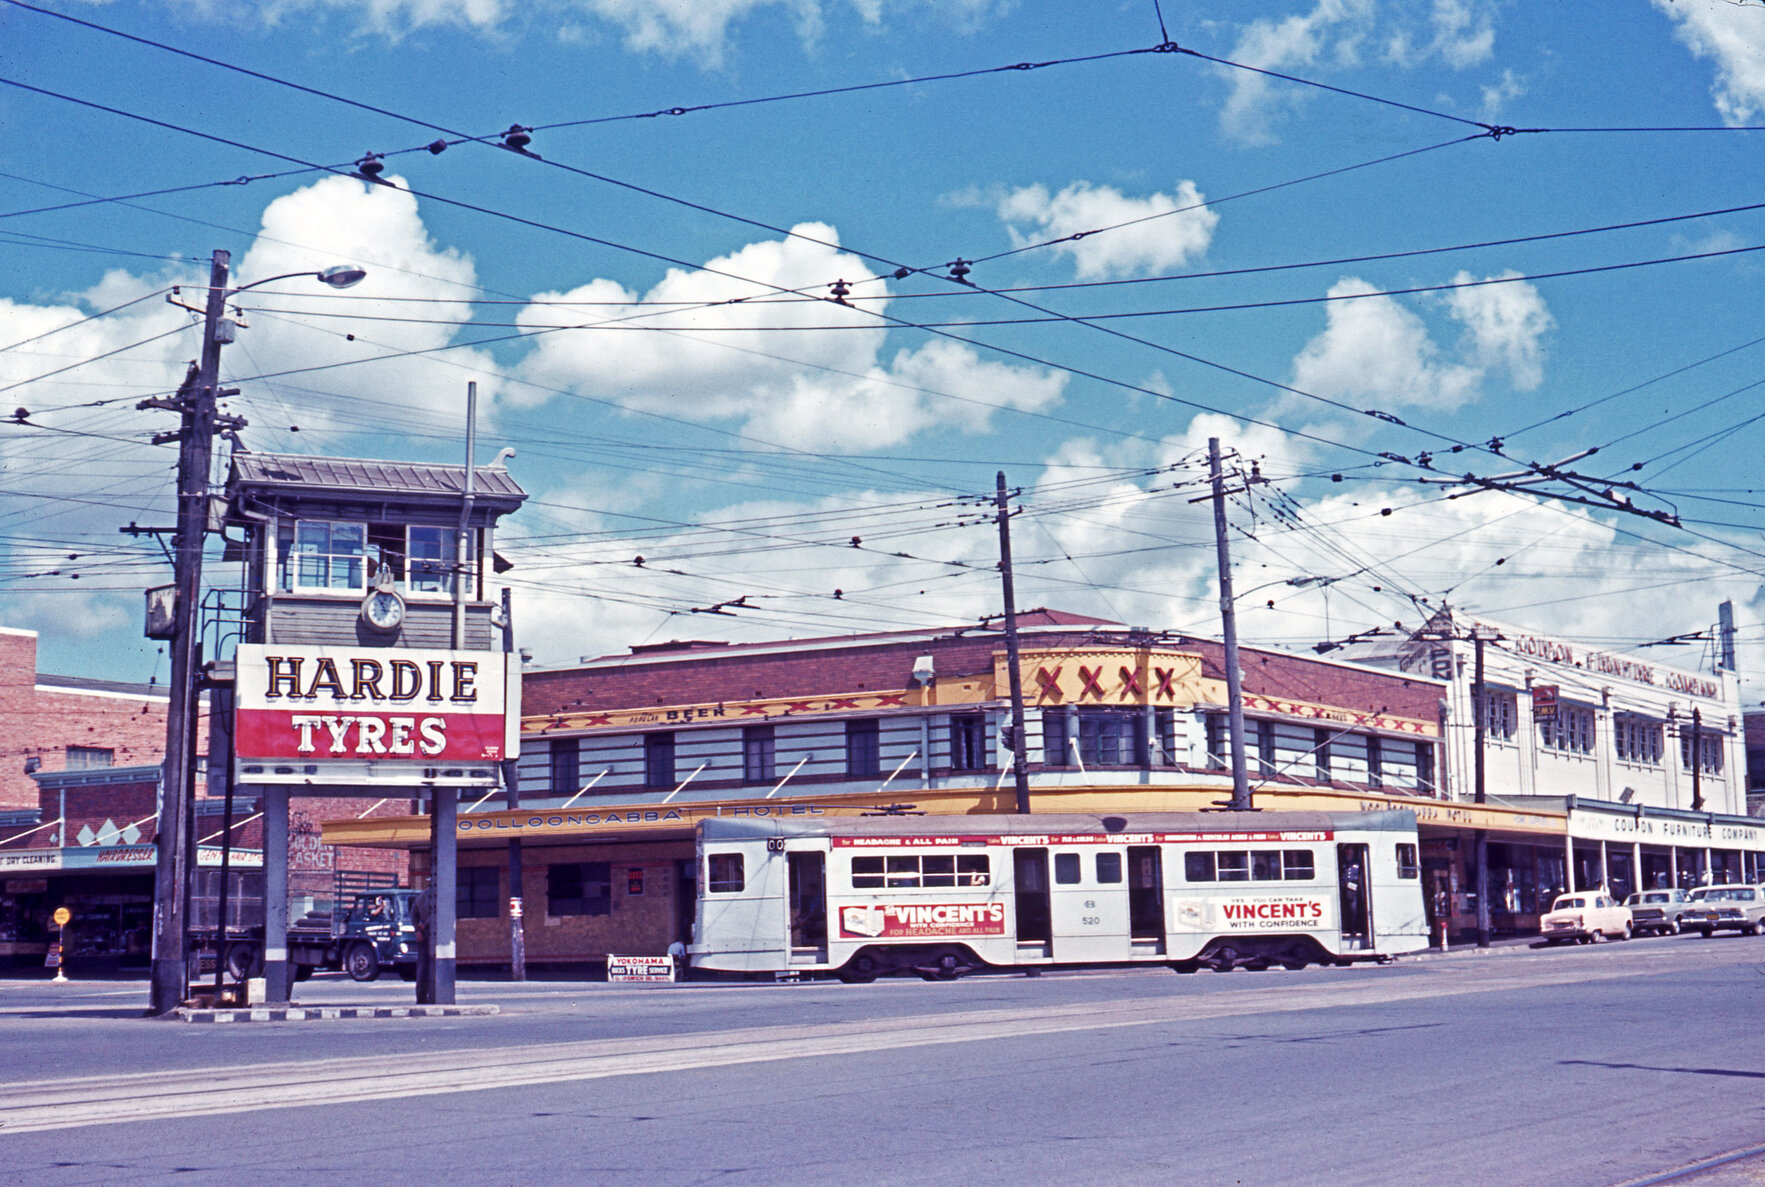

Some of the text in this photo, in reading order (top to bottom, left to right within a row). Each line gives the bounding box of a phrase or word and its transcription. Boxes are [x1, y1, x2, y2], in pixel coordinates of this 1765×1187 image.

[265, 656, 478, 702] HARDIE
[666, 708, 726, 721] BEER
[291, 714, 447, 755] TYRES
[458, 802, 824, 830] OOLLOONGABBA HOTEL
[1614, 818, 1653, 834] COUPON
[1663, 823, 1713, 839] FURNITURE
[1721, 827, 1758, 840] COMPANY
[853, 838, 901, 846] HEADACHE
[935, 837, 959, 845] PAIN
[96, 848, 154, 863] HAIRDRESSER
[896, 901, 1003, 924] VINCENT'S
[1223, 900, 1322, 919] VINCENT'S
[1081, 916, 1100, 925] 520
[1259, 919, 1319, 928] CONFIDENCE
[905, 927, 957, 936] HEADACHE
[984, 926, 1000, 934] PAIN
[625, 965, 648, 975] TYRE
